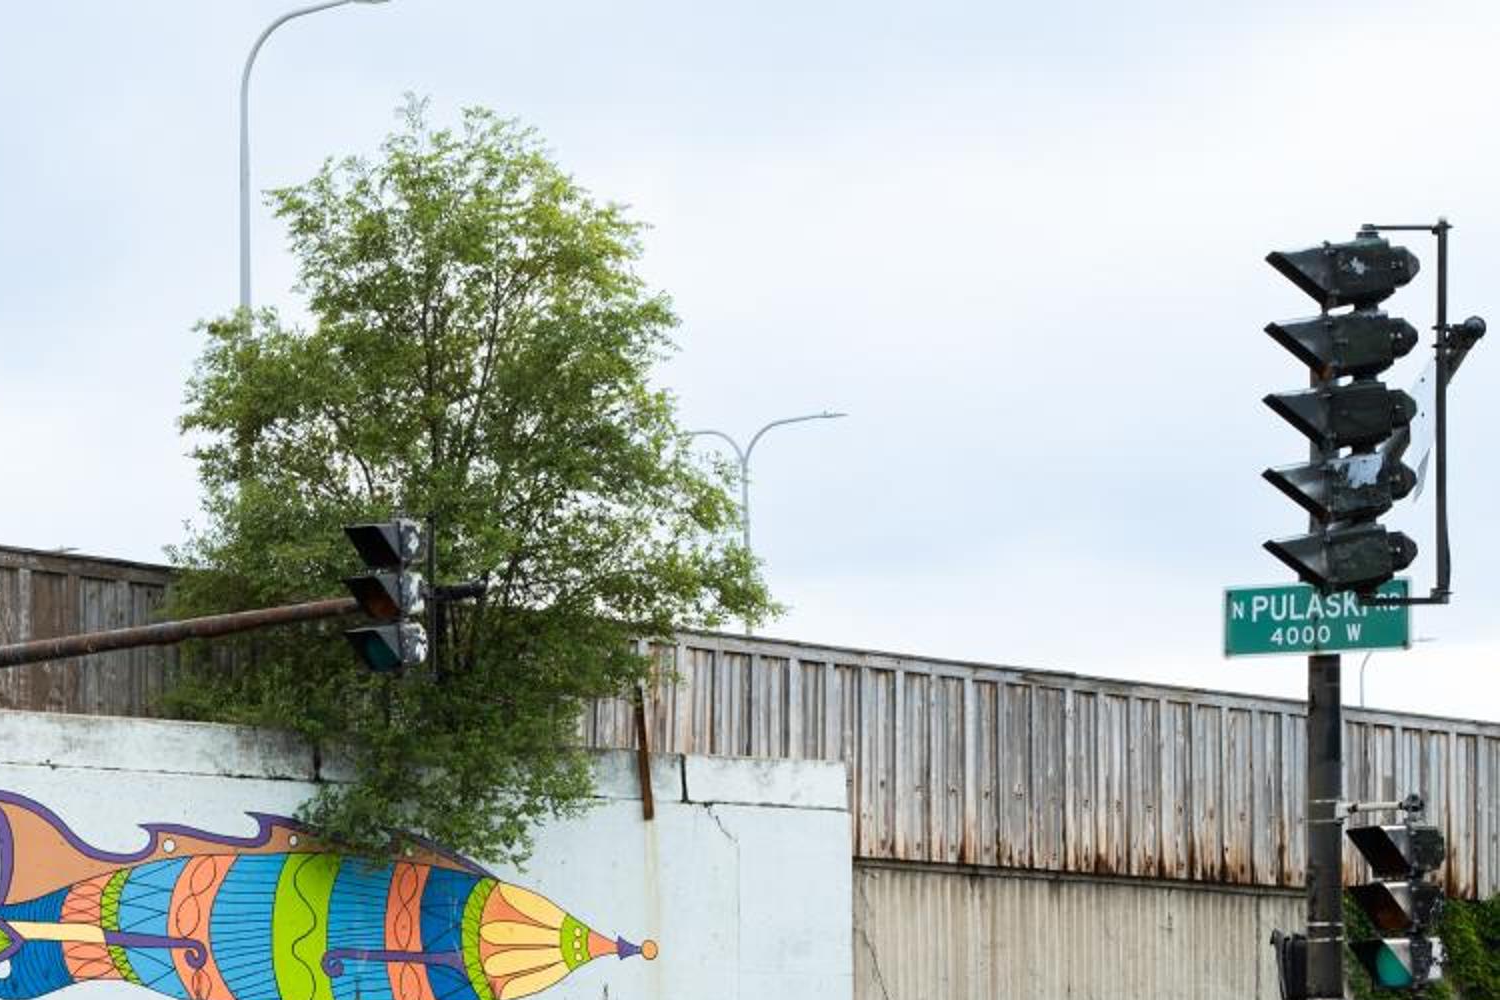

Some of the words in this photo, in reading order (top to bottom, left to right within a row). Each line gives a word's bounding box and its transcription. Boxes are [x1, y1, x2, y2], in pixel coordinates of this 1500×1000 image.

[1232, 601, 1245, 620] N
[1270, 625, 1331, 645] 4000
[1346, 623, 1362, 642] W
